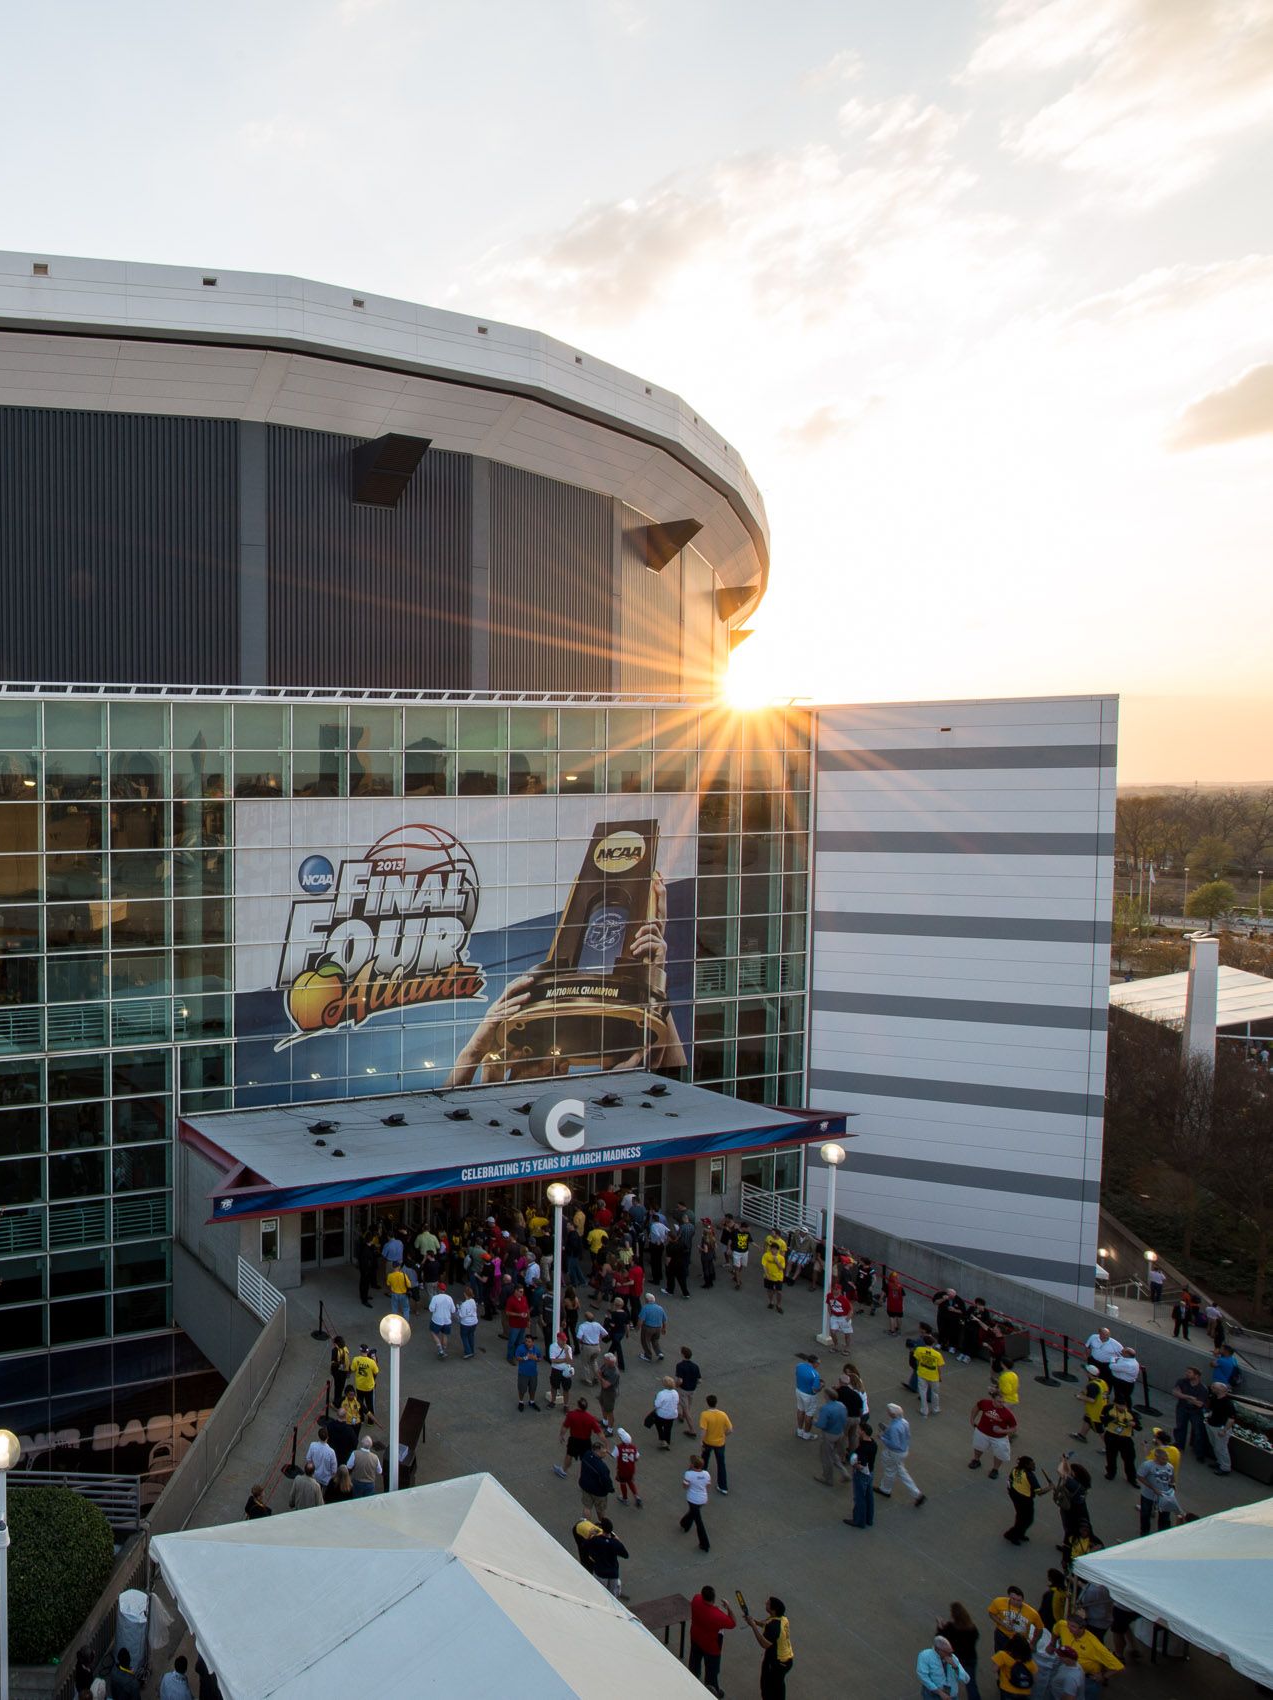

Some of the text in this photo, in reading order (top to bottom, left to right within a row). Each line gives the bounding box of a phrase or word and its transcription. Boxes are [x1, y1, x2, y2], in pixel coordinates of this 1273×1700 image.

[376, 860, 405, 871] 2013
[597, 846, 641, 860] NCAA
[302, 874, 335, 886] NCAA
[333, 861, 466, 918] FINAL
[278, 901, 467, 987] FOUR
[322, 954, 485, 1027] Atlanta
[546, 985, 619, 998] NATIONAL CHAMPION
[544, 1098, 585, 1153] C
[461, 1147, 642, 1181] CELEBRATING 75 YEARS OF MARCH MADNESS
